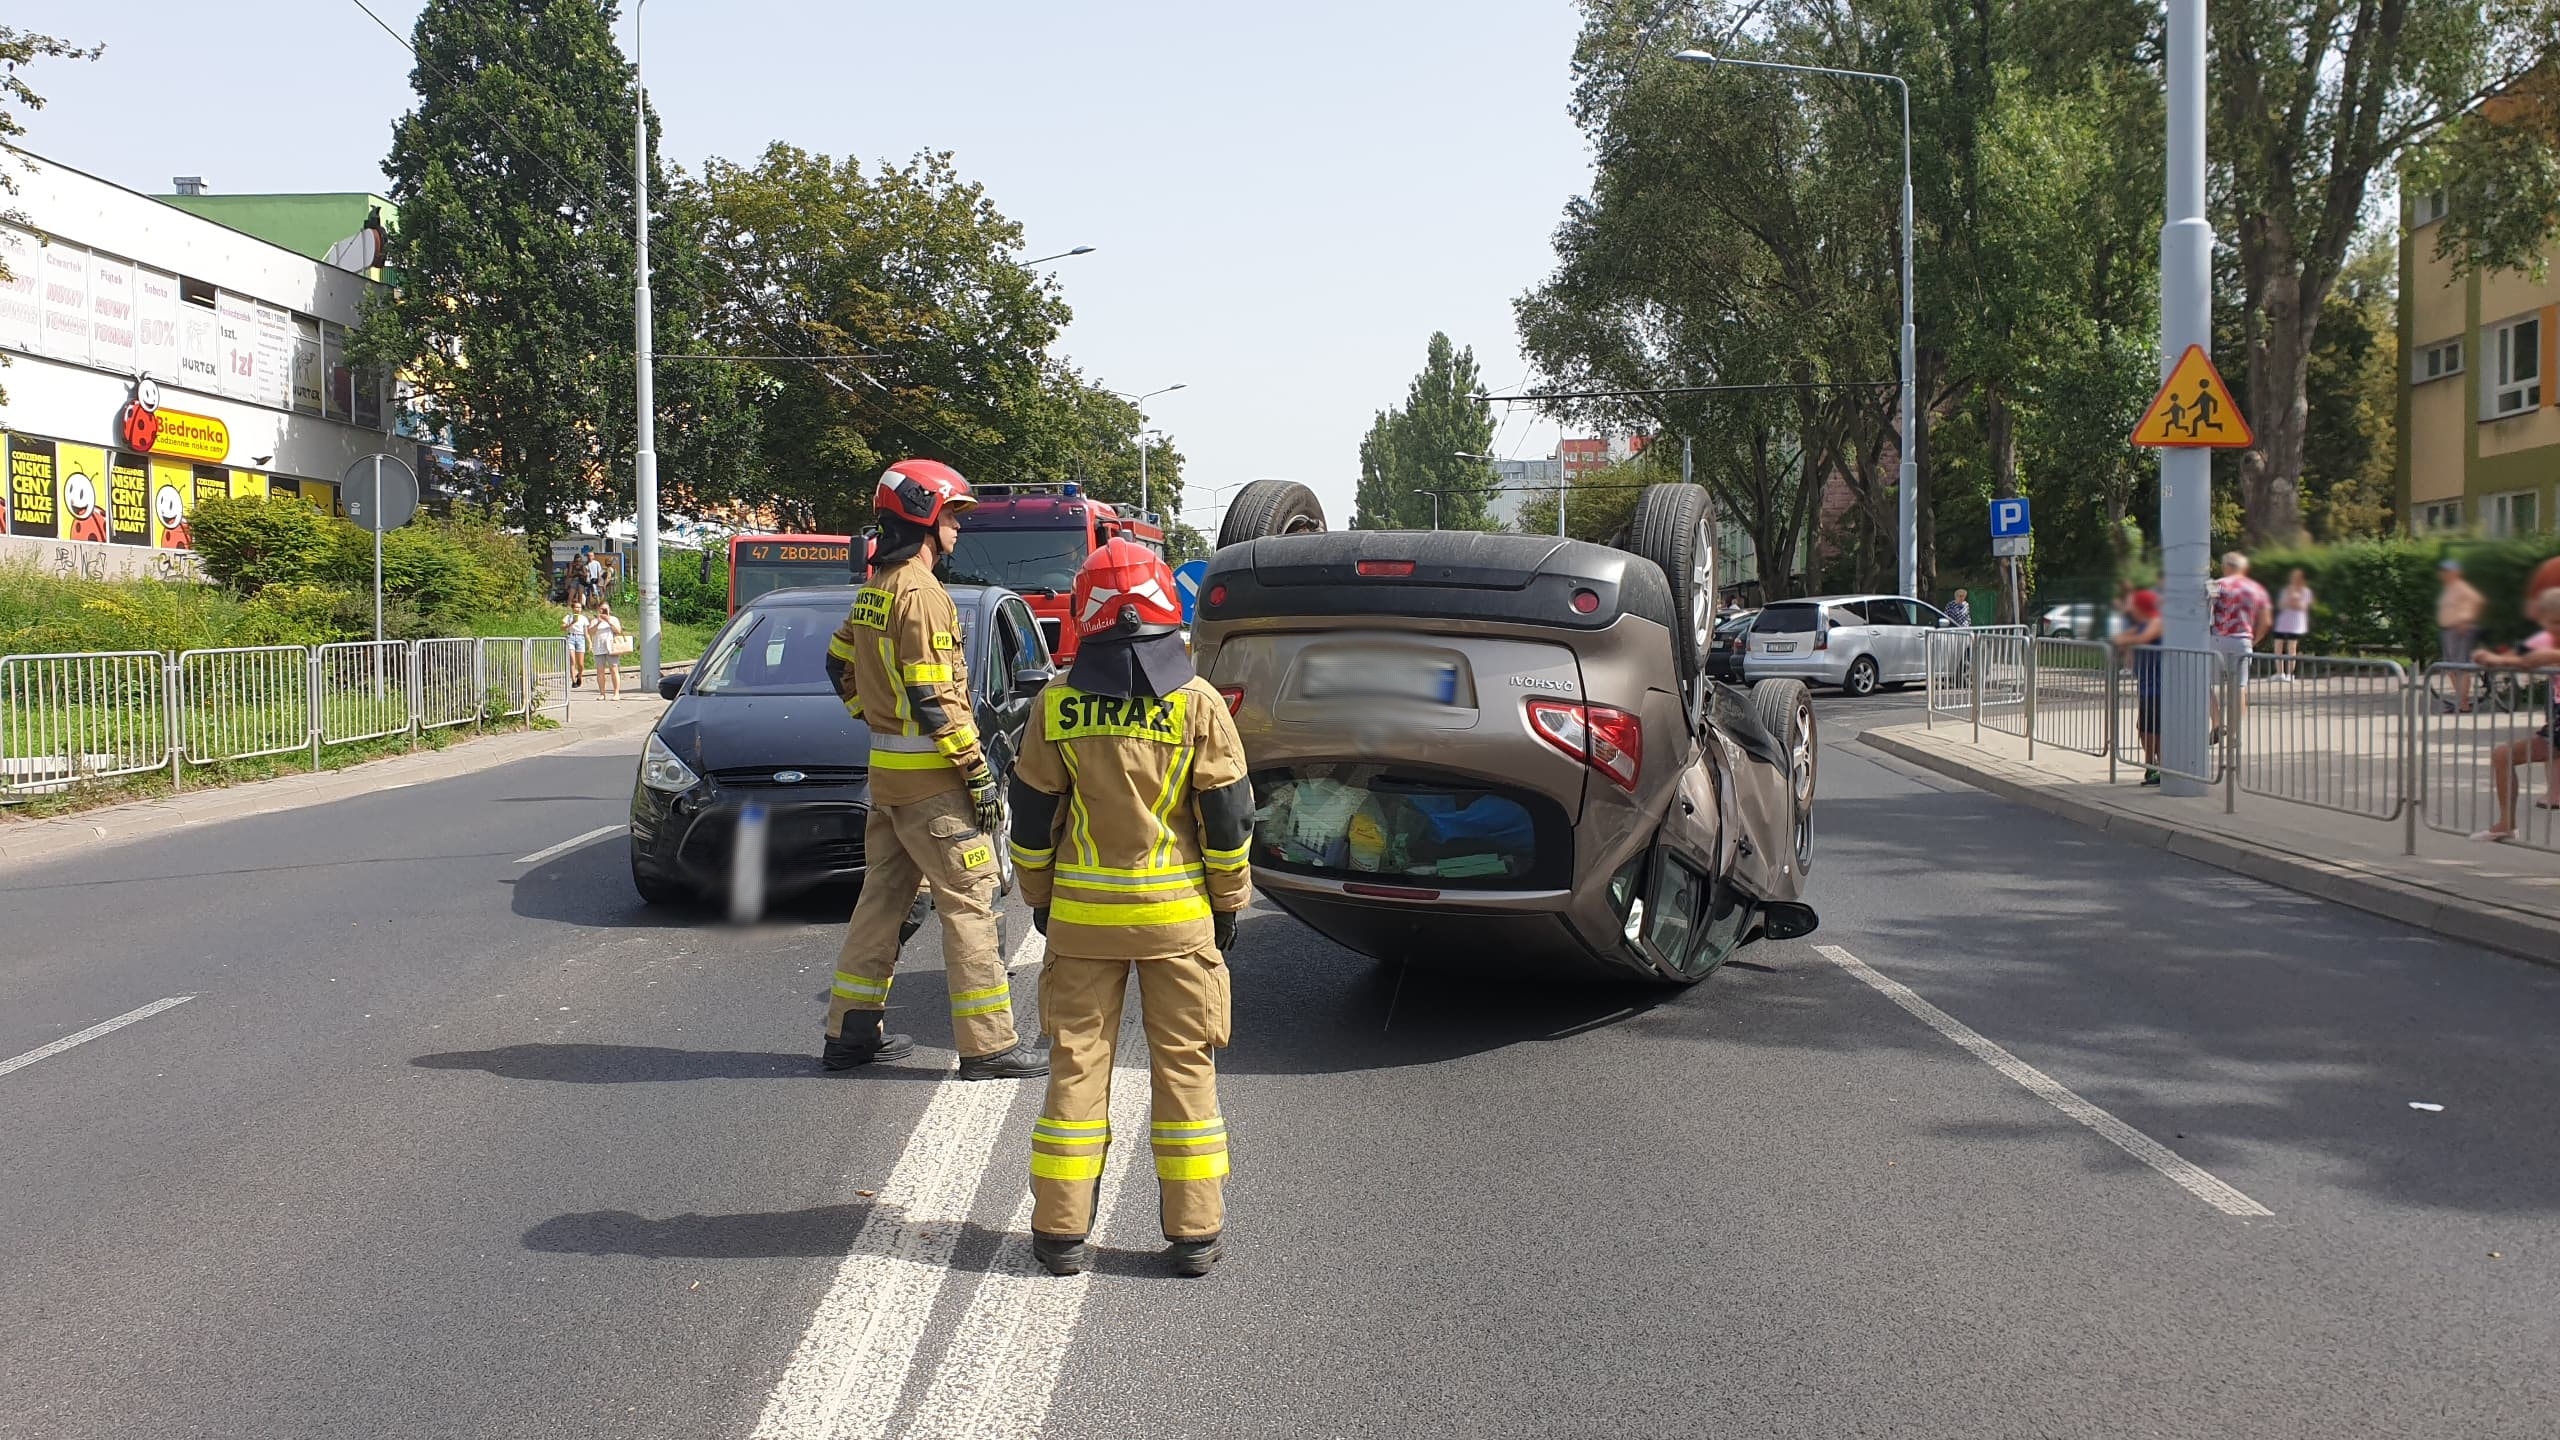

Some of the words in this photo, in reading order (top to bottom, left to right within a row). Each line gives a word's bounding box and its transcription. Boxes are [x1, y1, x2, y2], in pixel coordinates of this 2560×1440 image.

[95, 296, 130, 320] NOWY
[140, 318, 175, 346] 50%
[156, 416, 223, 443] Biedronka
[12, 460, 51, 478] NISKIE
[13, 475, 51, 495] CENY
[112, 474, 145, 490] NISKIE
[112, 488, 144, 506] CENY
[14, 509, 52, 524] RABATY
[1999, 503, 2022, 532] P
[113, 519, 146, 533] RABATY
[752, 546, 769, 559] 47
[779, 546, 849, 561] ZBOŻOWA
[1080, 617, 1117, 633] Madzia
[936, 635, 950, 646] PSP
[1510, 676, 1574, 691] QASHQAI
[968, 850, 986, 864] PSP
